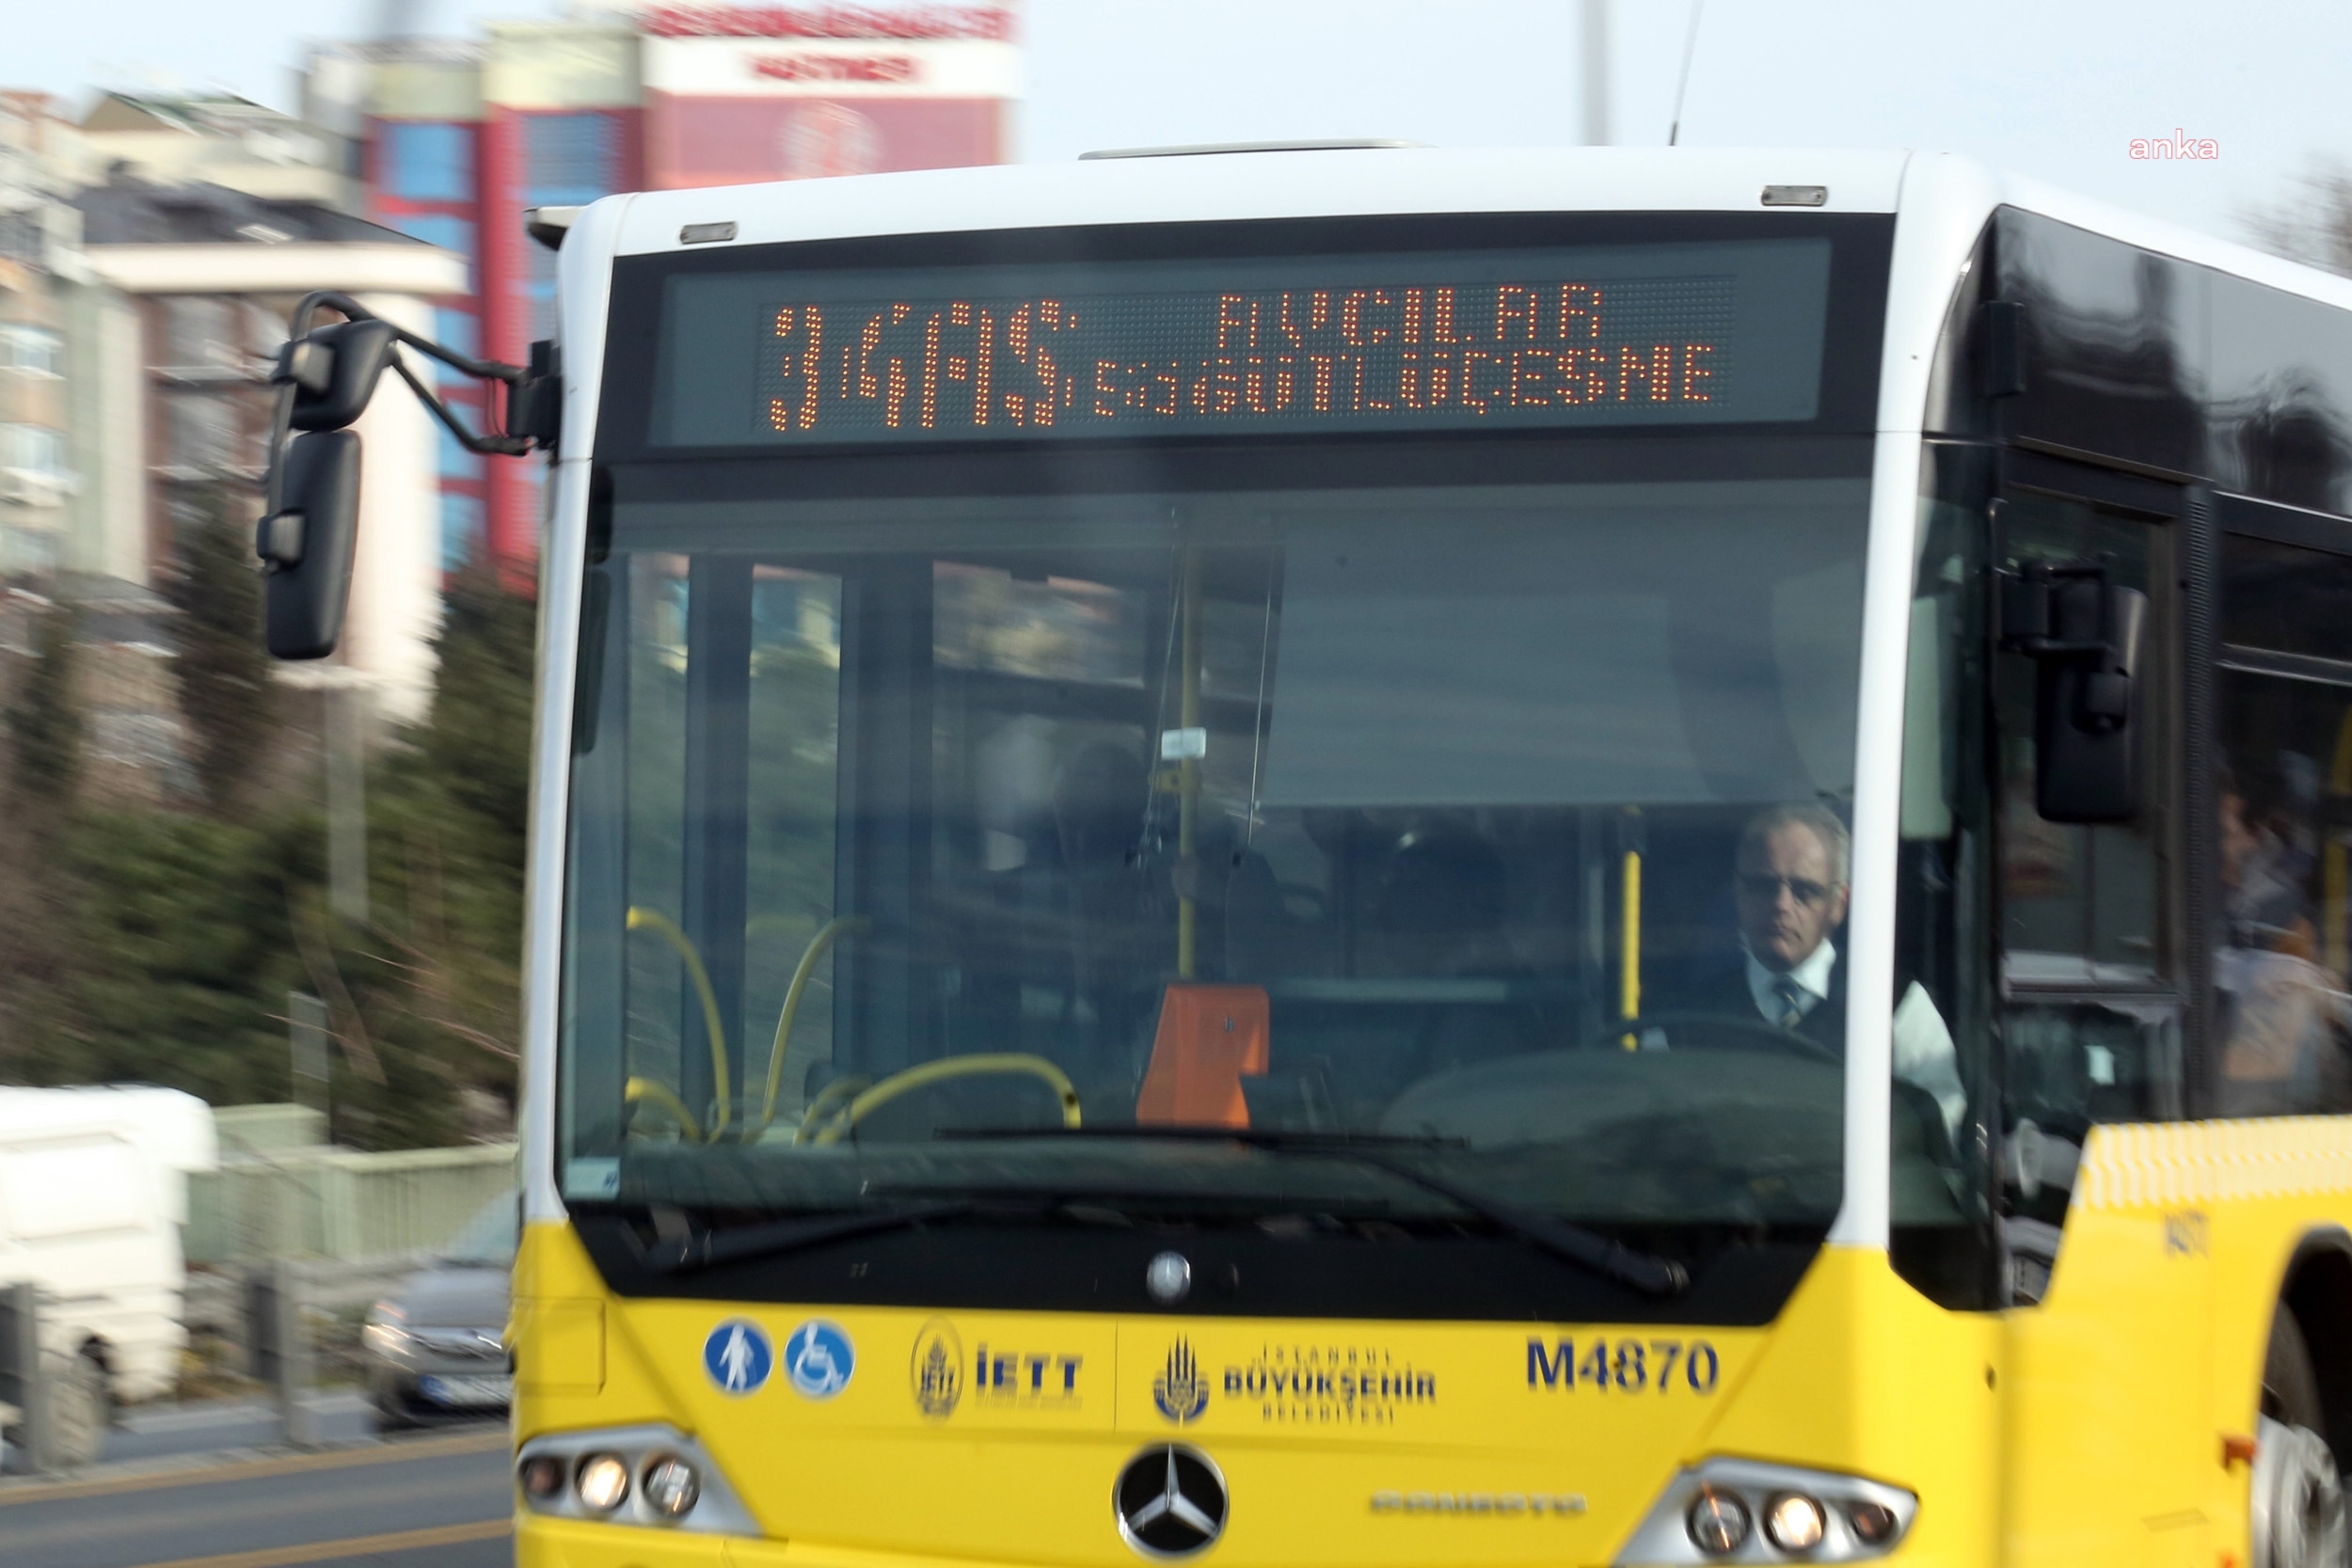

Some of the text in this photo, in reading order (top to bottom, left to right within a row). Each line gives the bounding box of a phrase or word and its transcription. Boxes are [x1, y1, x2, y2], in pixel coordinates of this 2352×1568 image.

[1218, 285, 1601, 349] AVCILAR
[770, 298, 1076, 433] 34AS
[1525, 1335, 1720, 1396] M4870
